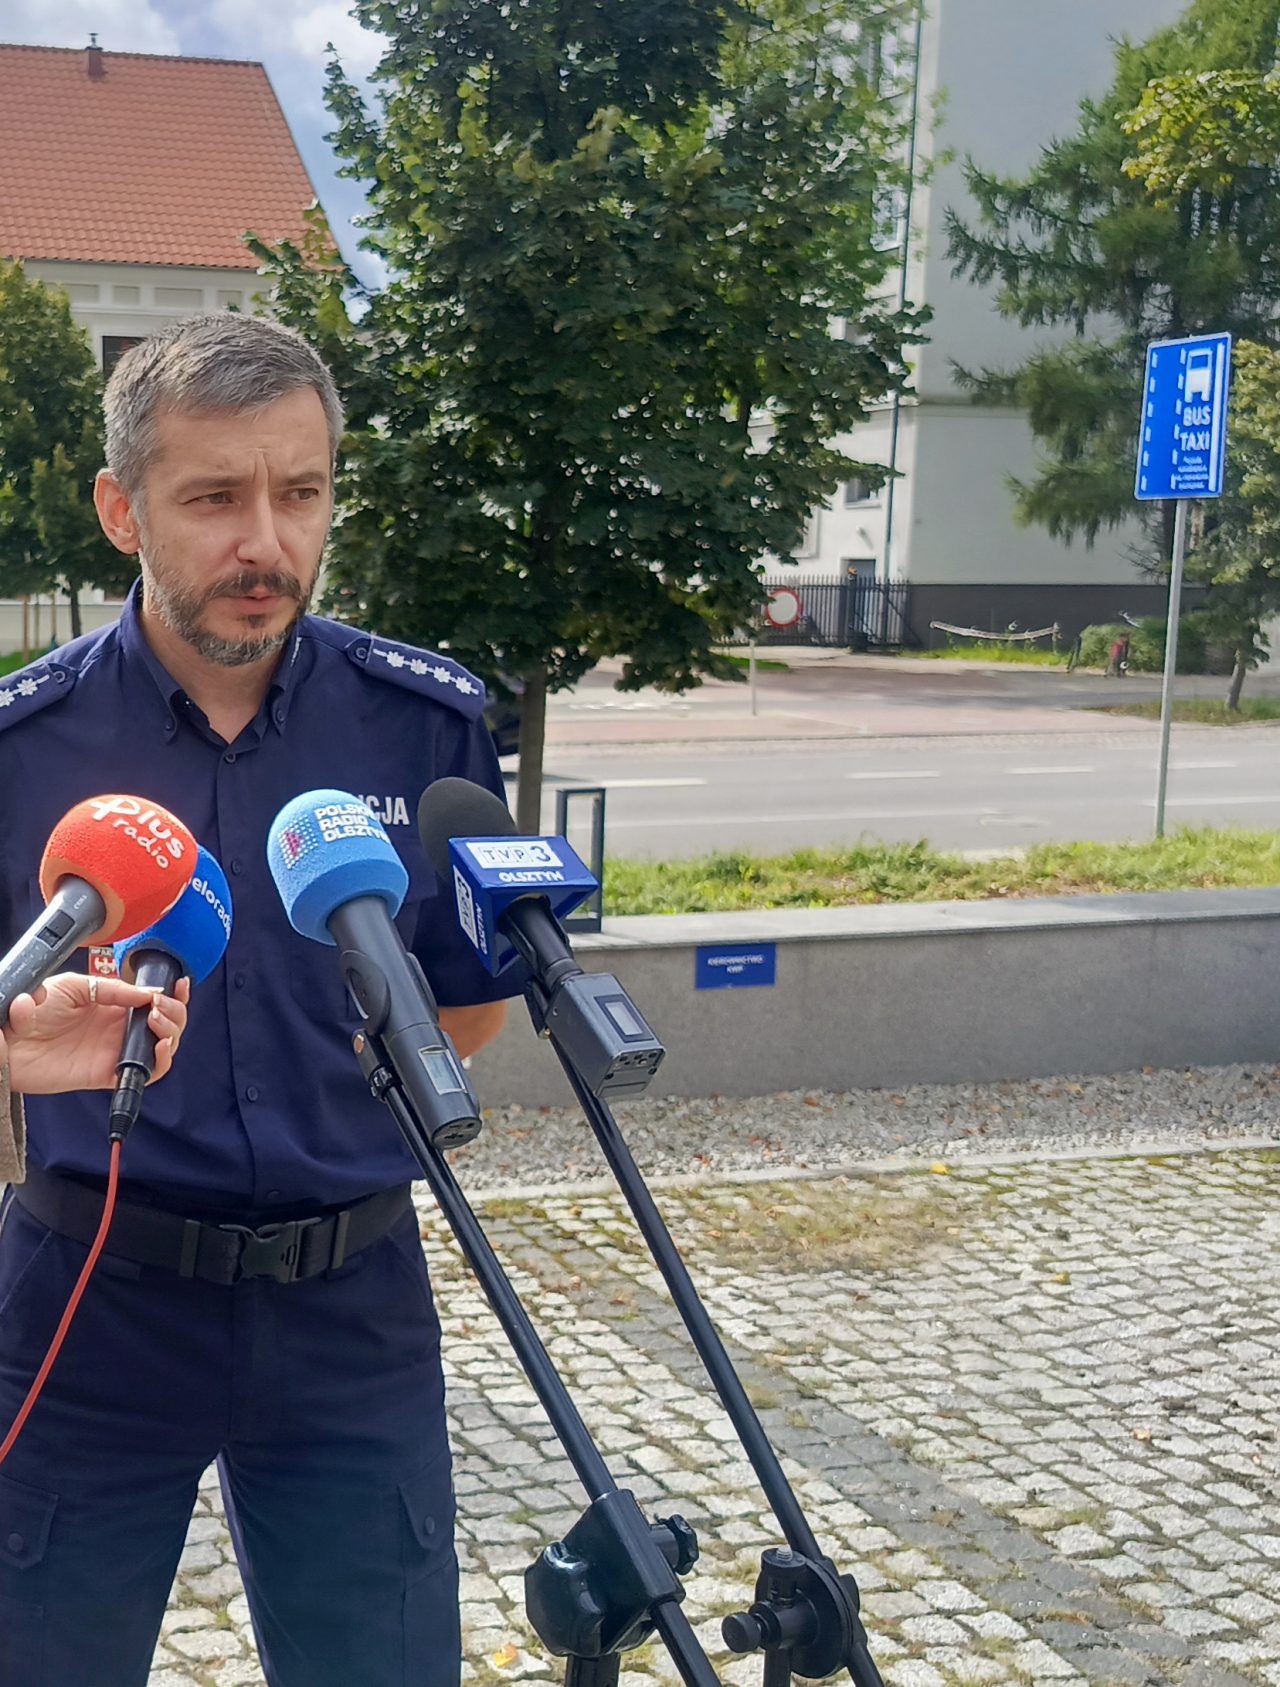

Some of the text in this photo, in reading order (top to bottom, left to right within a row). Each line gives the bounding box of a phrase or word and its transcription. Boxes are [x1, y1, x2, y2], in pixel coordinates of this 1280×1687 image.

[1183, 405, 1211, 427] BUS
[1180, 431, 1210, 451] TAXI
[319, 814, 369, 831] RADIO
[112, 819, 169, 868] radio
[498, 870, 565, 882] OLSZTYN
